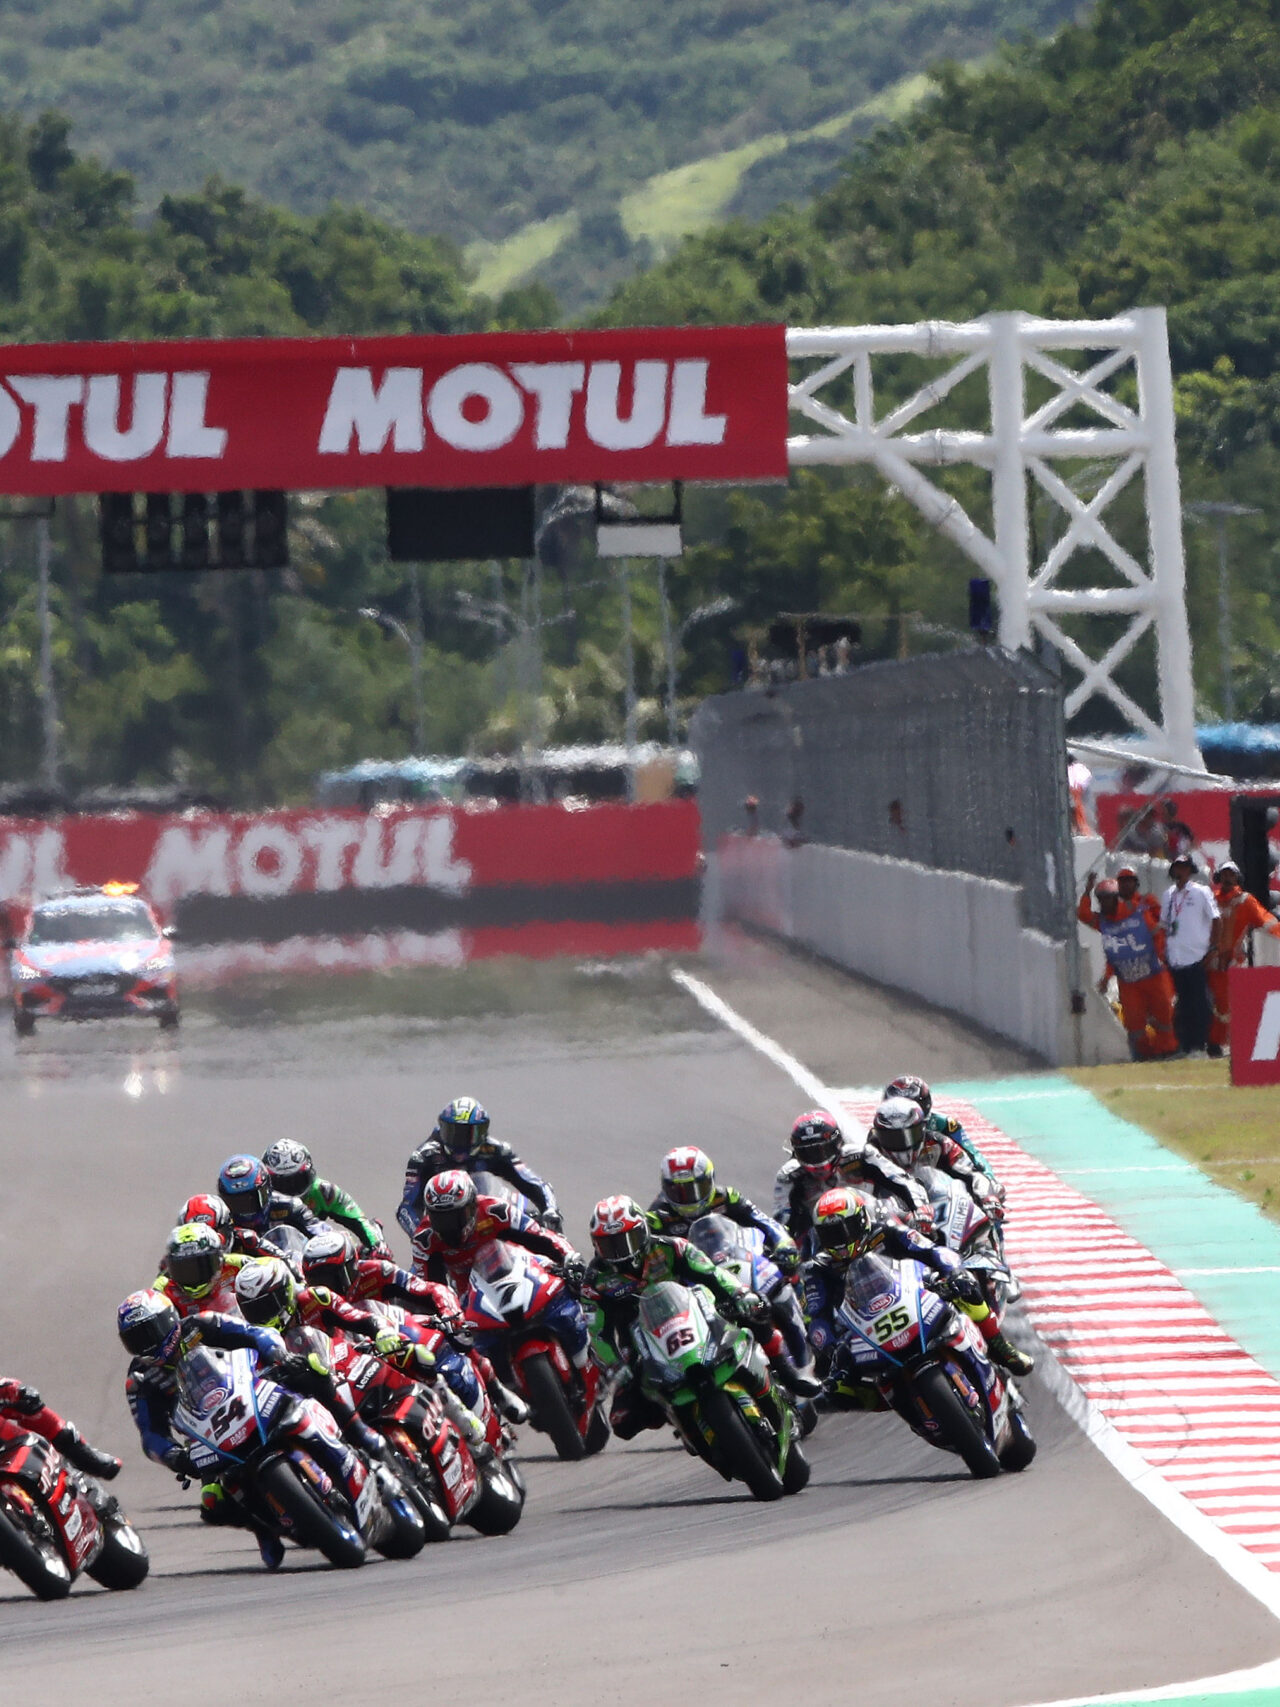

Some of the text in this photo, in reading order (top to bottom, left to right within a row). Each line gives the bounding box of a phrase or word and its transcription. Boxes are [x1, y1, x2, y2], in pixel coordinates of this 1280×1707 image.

[318, 358, 727, 454] MOTUL
[144, 815, 472, 900] MOTUL
[873, 1306, 910, 1342] 55
[924, 1302, 943, 1325] YAMAHA
[666, 1327, 694, 1356] 65
[355, 1361, 380, 1389] Lenovo
[210, 1396, 248, 1441] 54
[261, 1392, 282, 1417] YAMAHA
